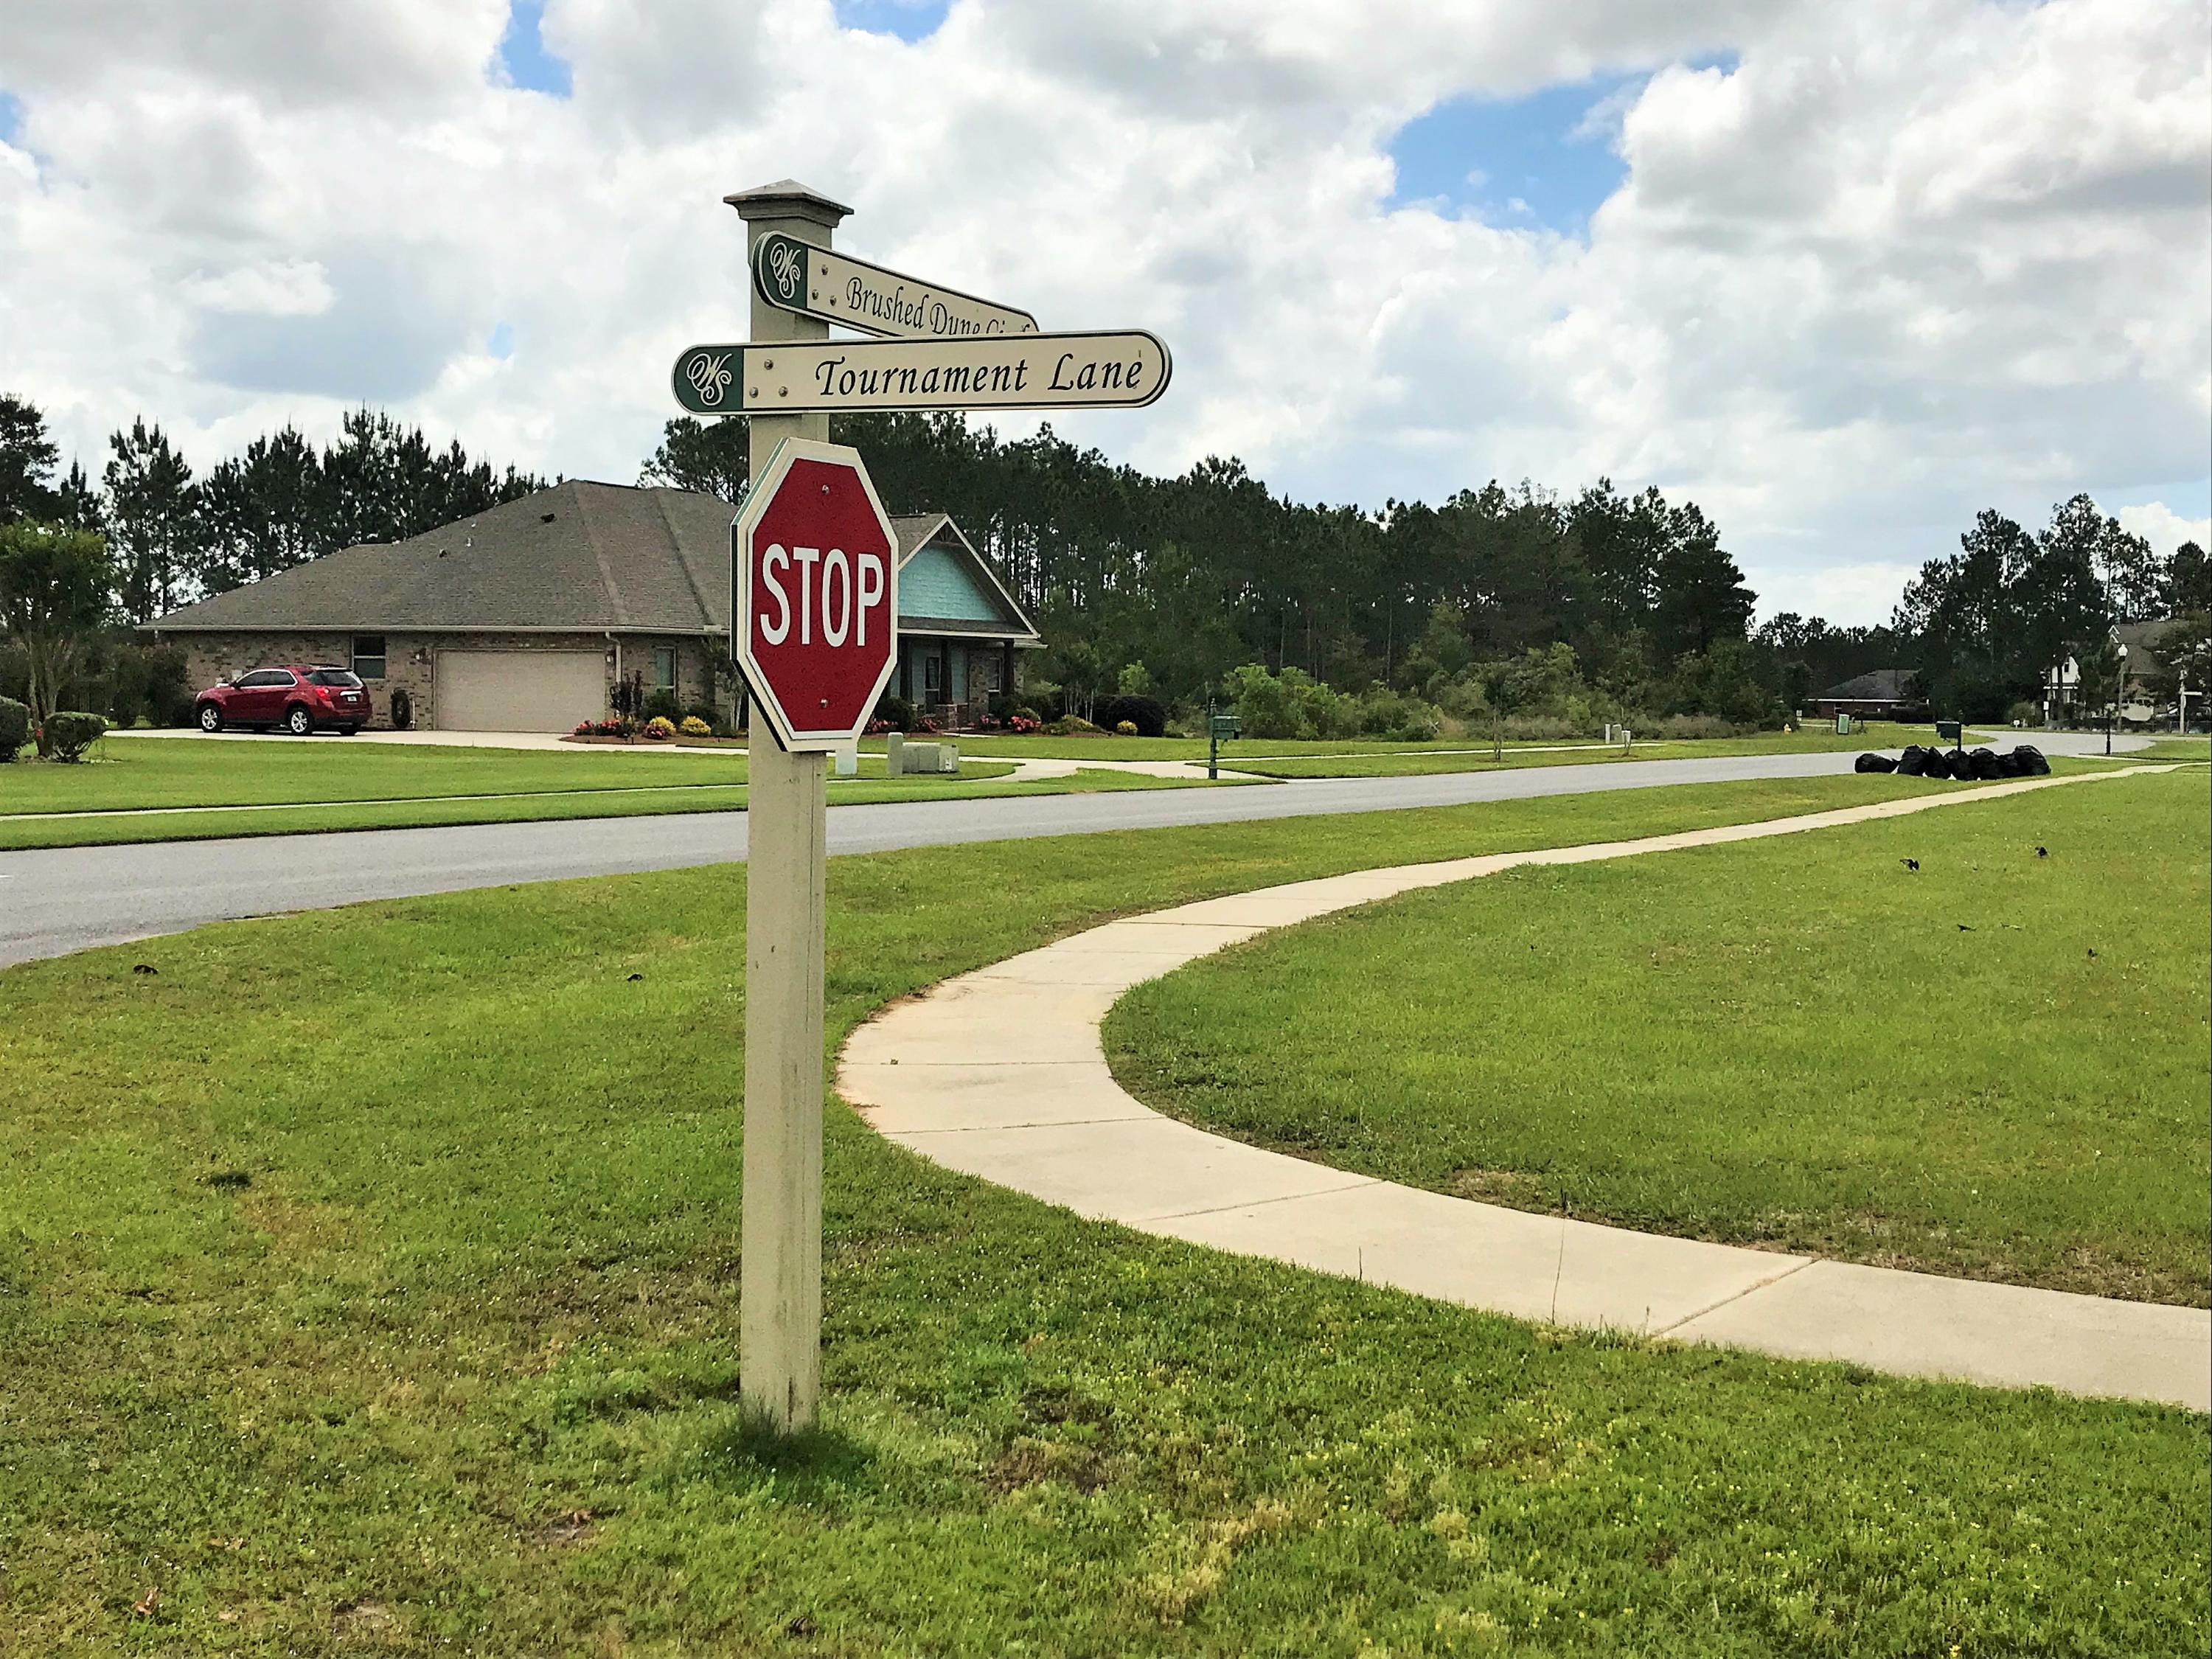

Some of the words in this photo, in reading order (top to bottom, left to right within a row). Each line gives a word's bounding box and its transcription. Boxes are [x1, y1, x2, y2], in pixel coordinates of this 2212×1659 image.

[846, 276, 930, 330] Brushed
[815, 355, 1029, 396] Tournament
[1046, 352, 1143, 392] Lane
[759, 543, 884, 648] STOP
